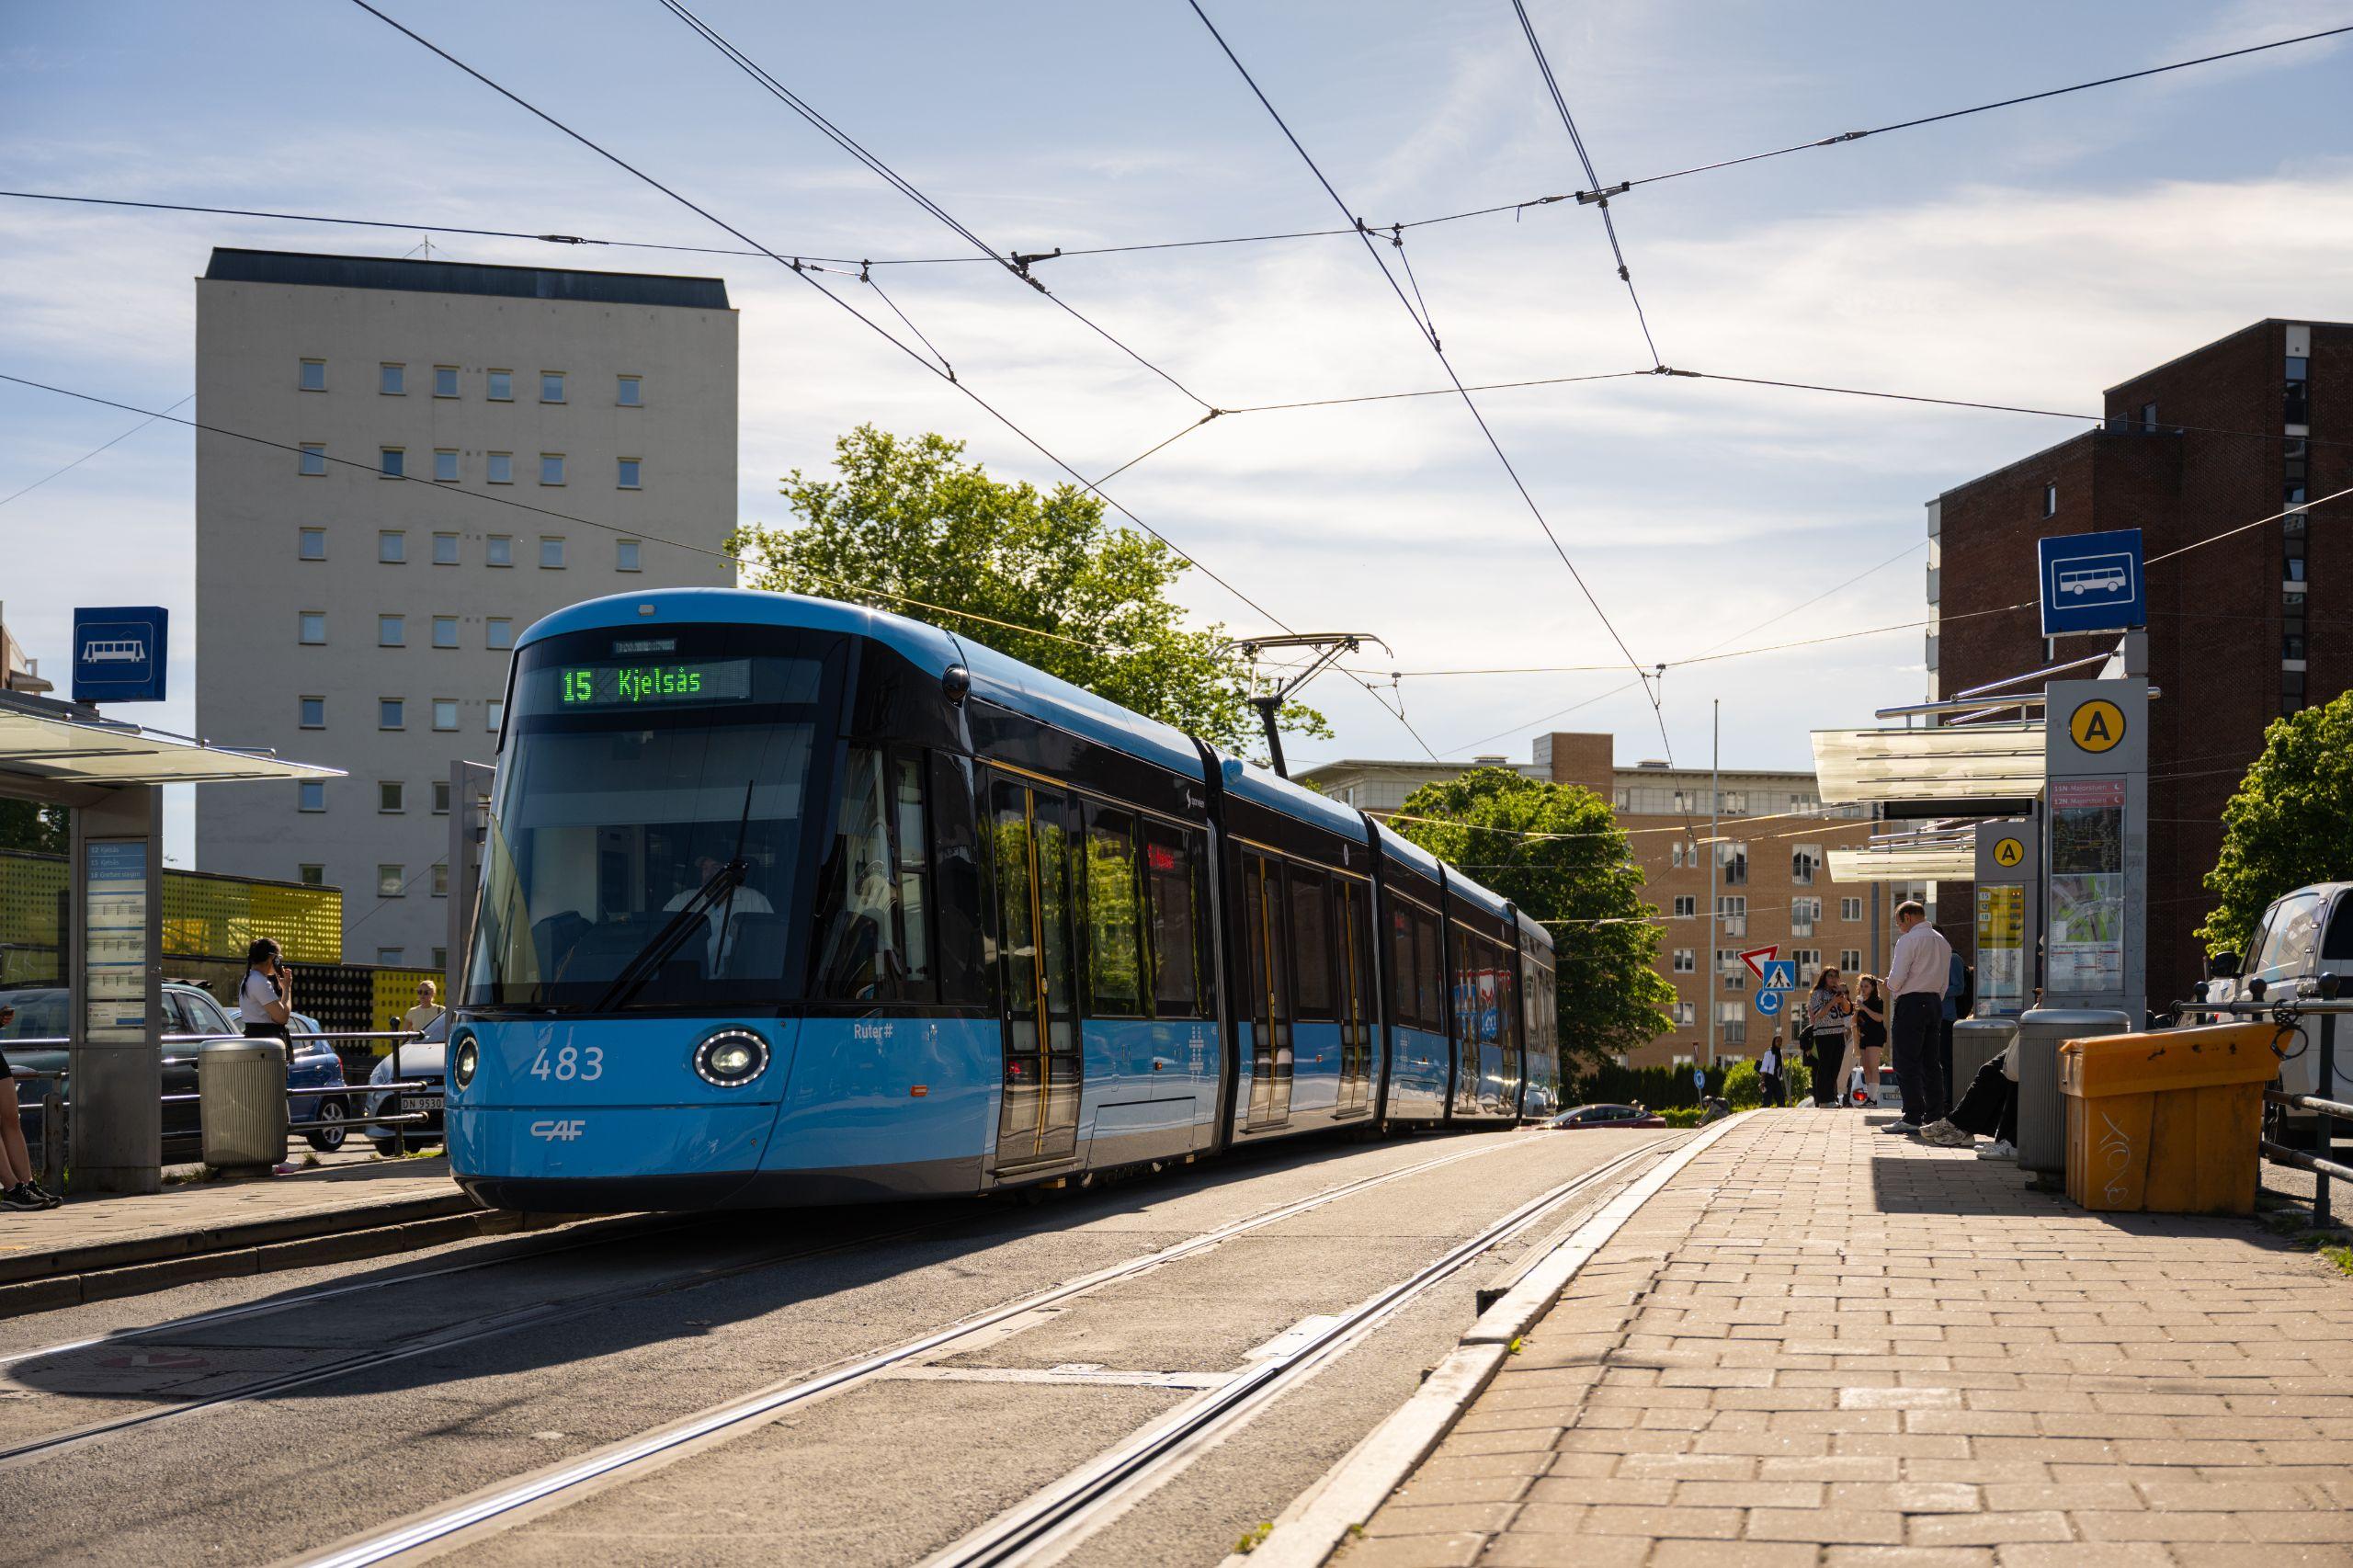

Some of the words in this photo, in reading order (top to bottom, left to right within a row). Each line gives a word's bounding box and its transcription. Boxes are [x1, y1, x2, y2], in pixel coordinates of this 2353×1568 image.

[564, 671, 592, 701] 15
[619, 666, 700, 701] Kjelsås
[2084, 710, 2111, 742] A
[2001, 843, 2017, 861] A
[854, 1023, 893, 1040] Ruter#
[529, 1046, 604, 1081] 483
[403, 1099, 415, 1108] DN
[419, 1098, 441, 1108] 9530
[529, 1119, 586, 1142] CAF
